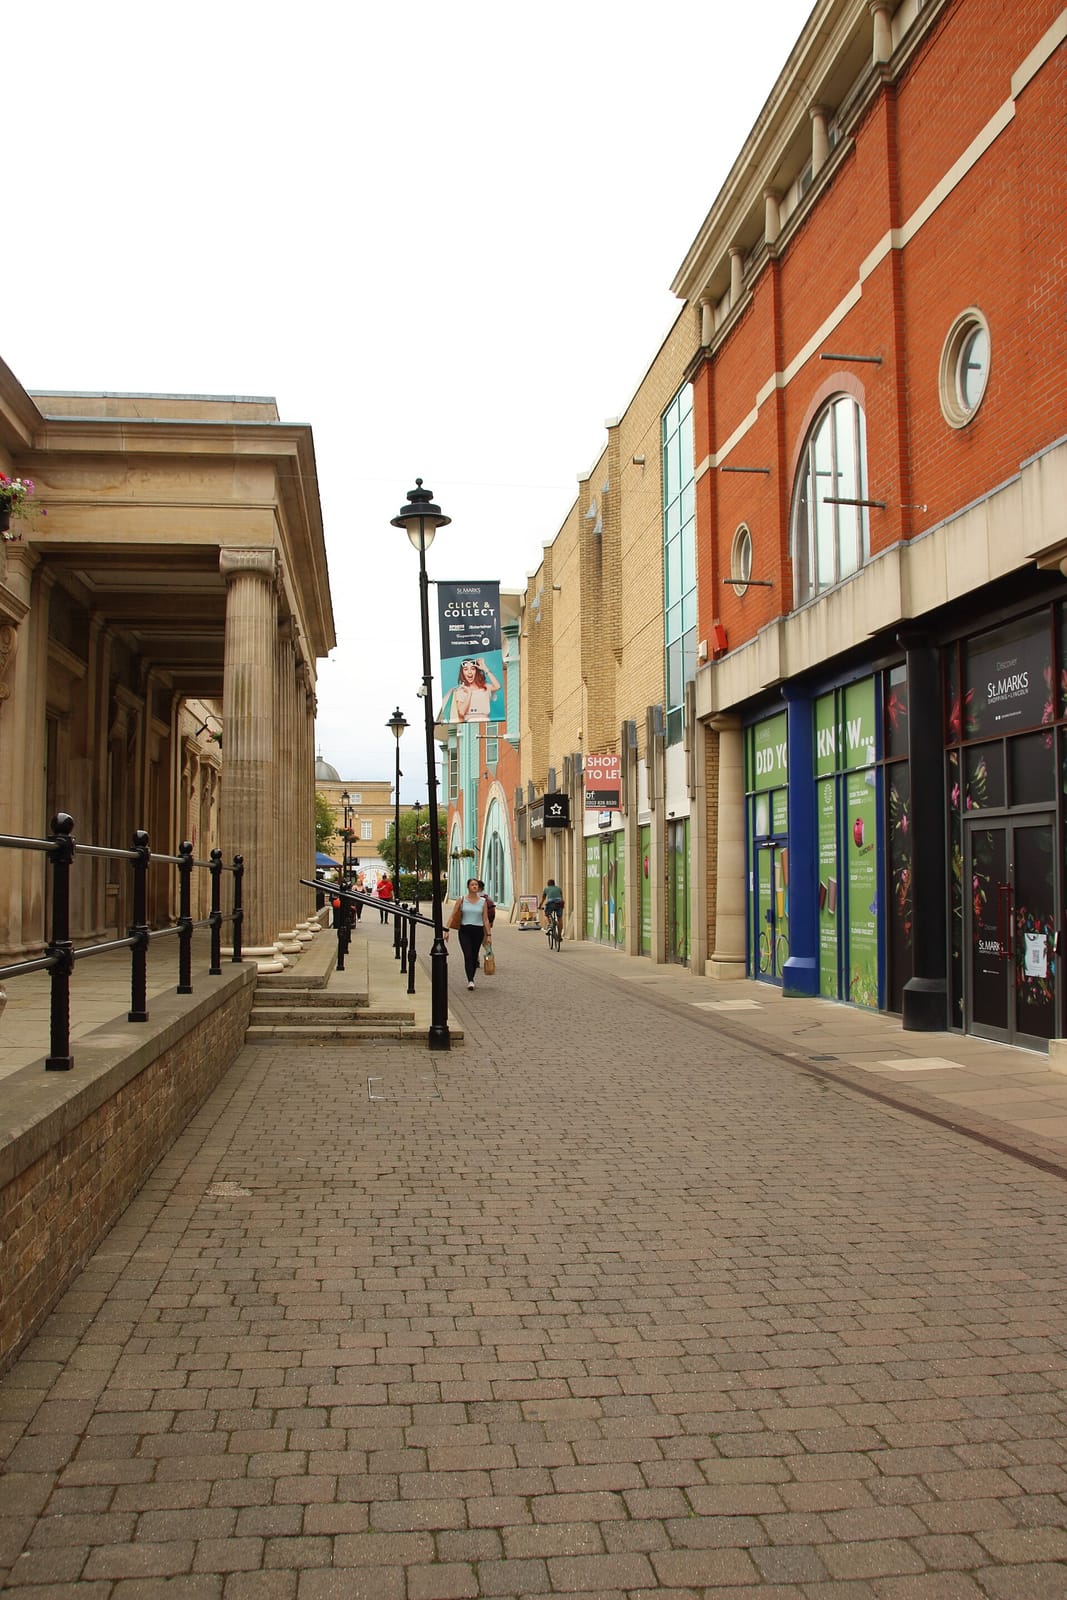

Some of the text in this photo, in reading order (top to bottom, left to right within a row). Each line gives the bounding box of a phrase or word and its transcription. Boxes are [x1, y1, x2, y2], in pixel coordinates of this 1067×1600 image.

[444, 609, 495, 617] COLLECT
[987, 672, 1029, 698] St.MARKS
[588, 757, 617, 767] SHOP
[756, 747, 774, 775] DID
[587, 770, 621, 779] TO LET
